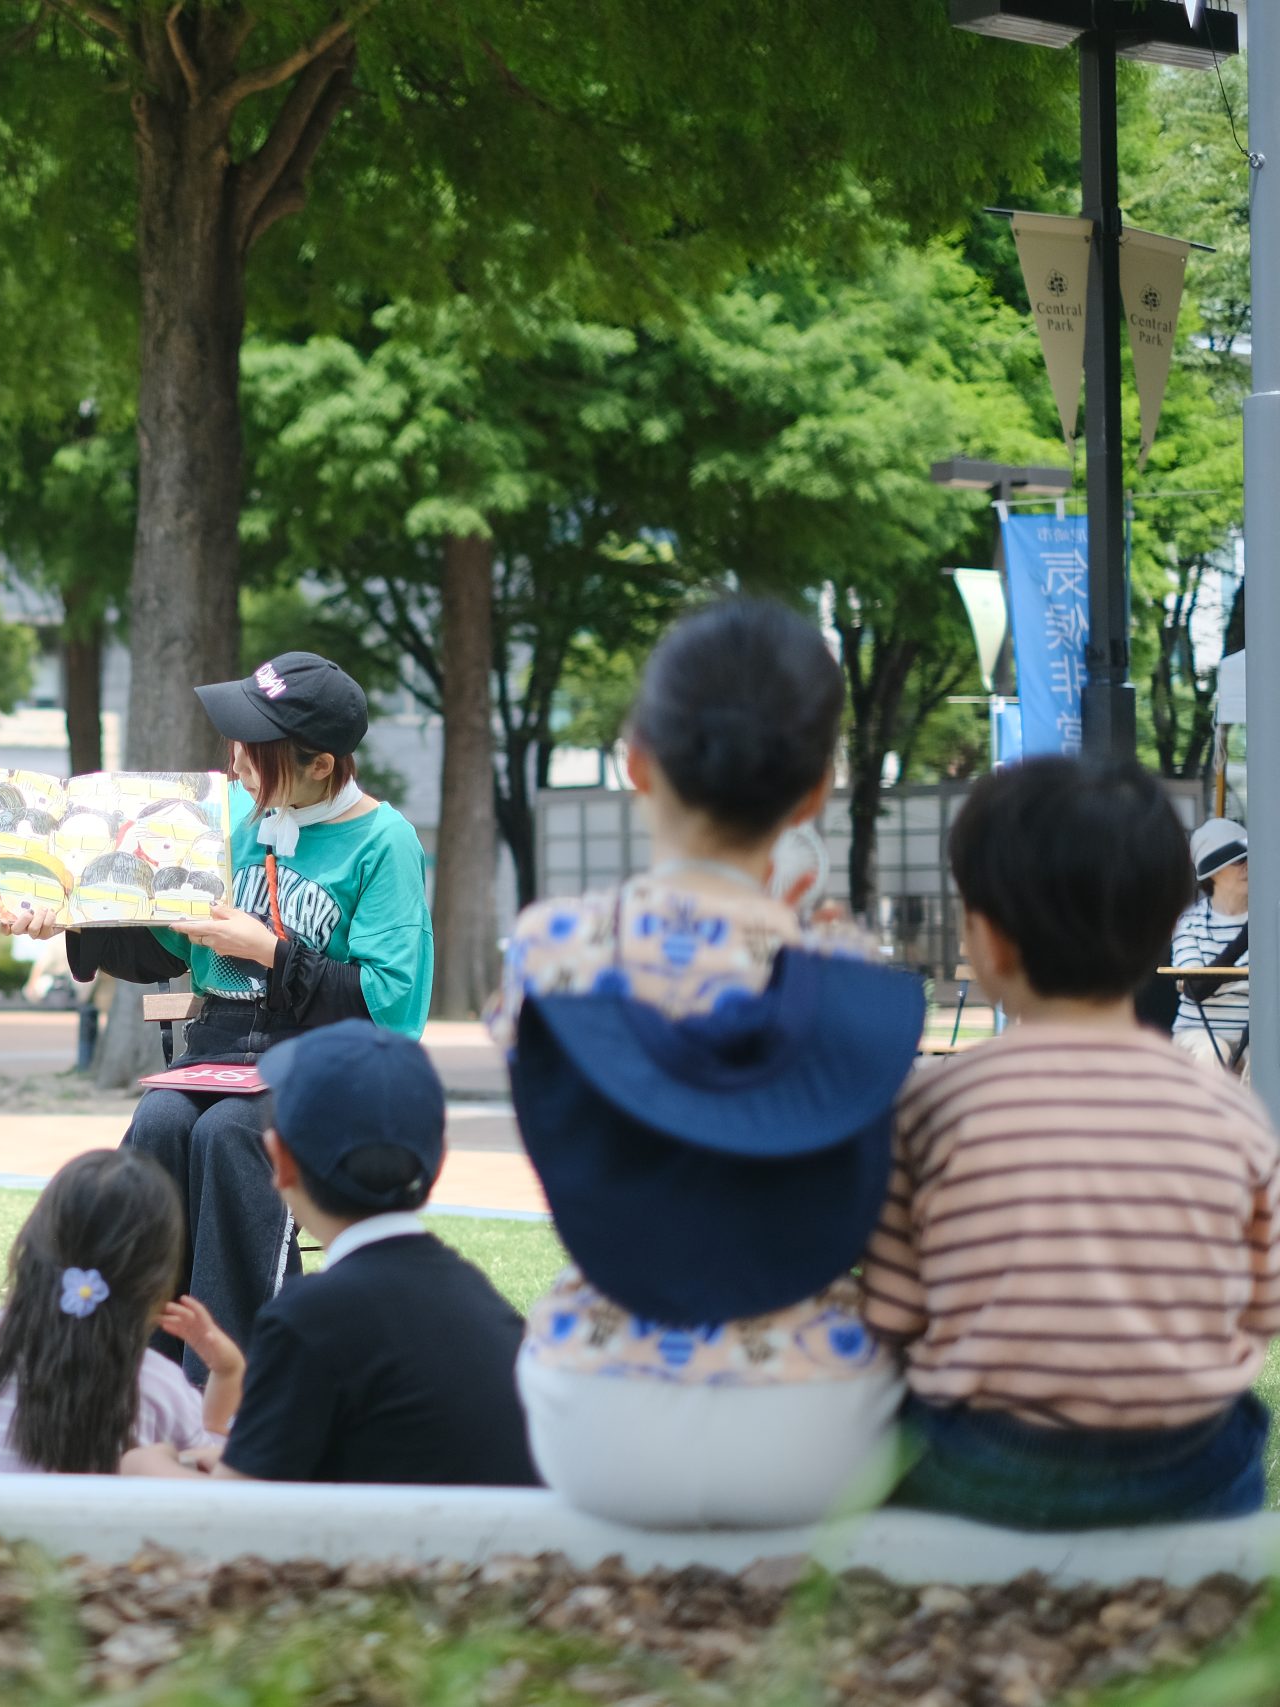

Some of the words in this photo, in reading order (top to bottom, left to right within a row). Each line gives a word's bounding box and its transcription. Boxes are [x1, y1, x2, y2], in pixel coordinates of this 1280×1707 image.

[1036, 302, 1082, 317] Central
[1047, 319, 1074, 332] Park
[1129, 313, 1172, 333] Central
[1139, 330, 1163, 347] Park
